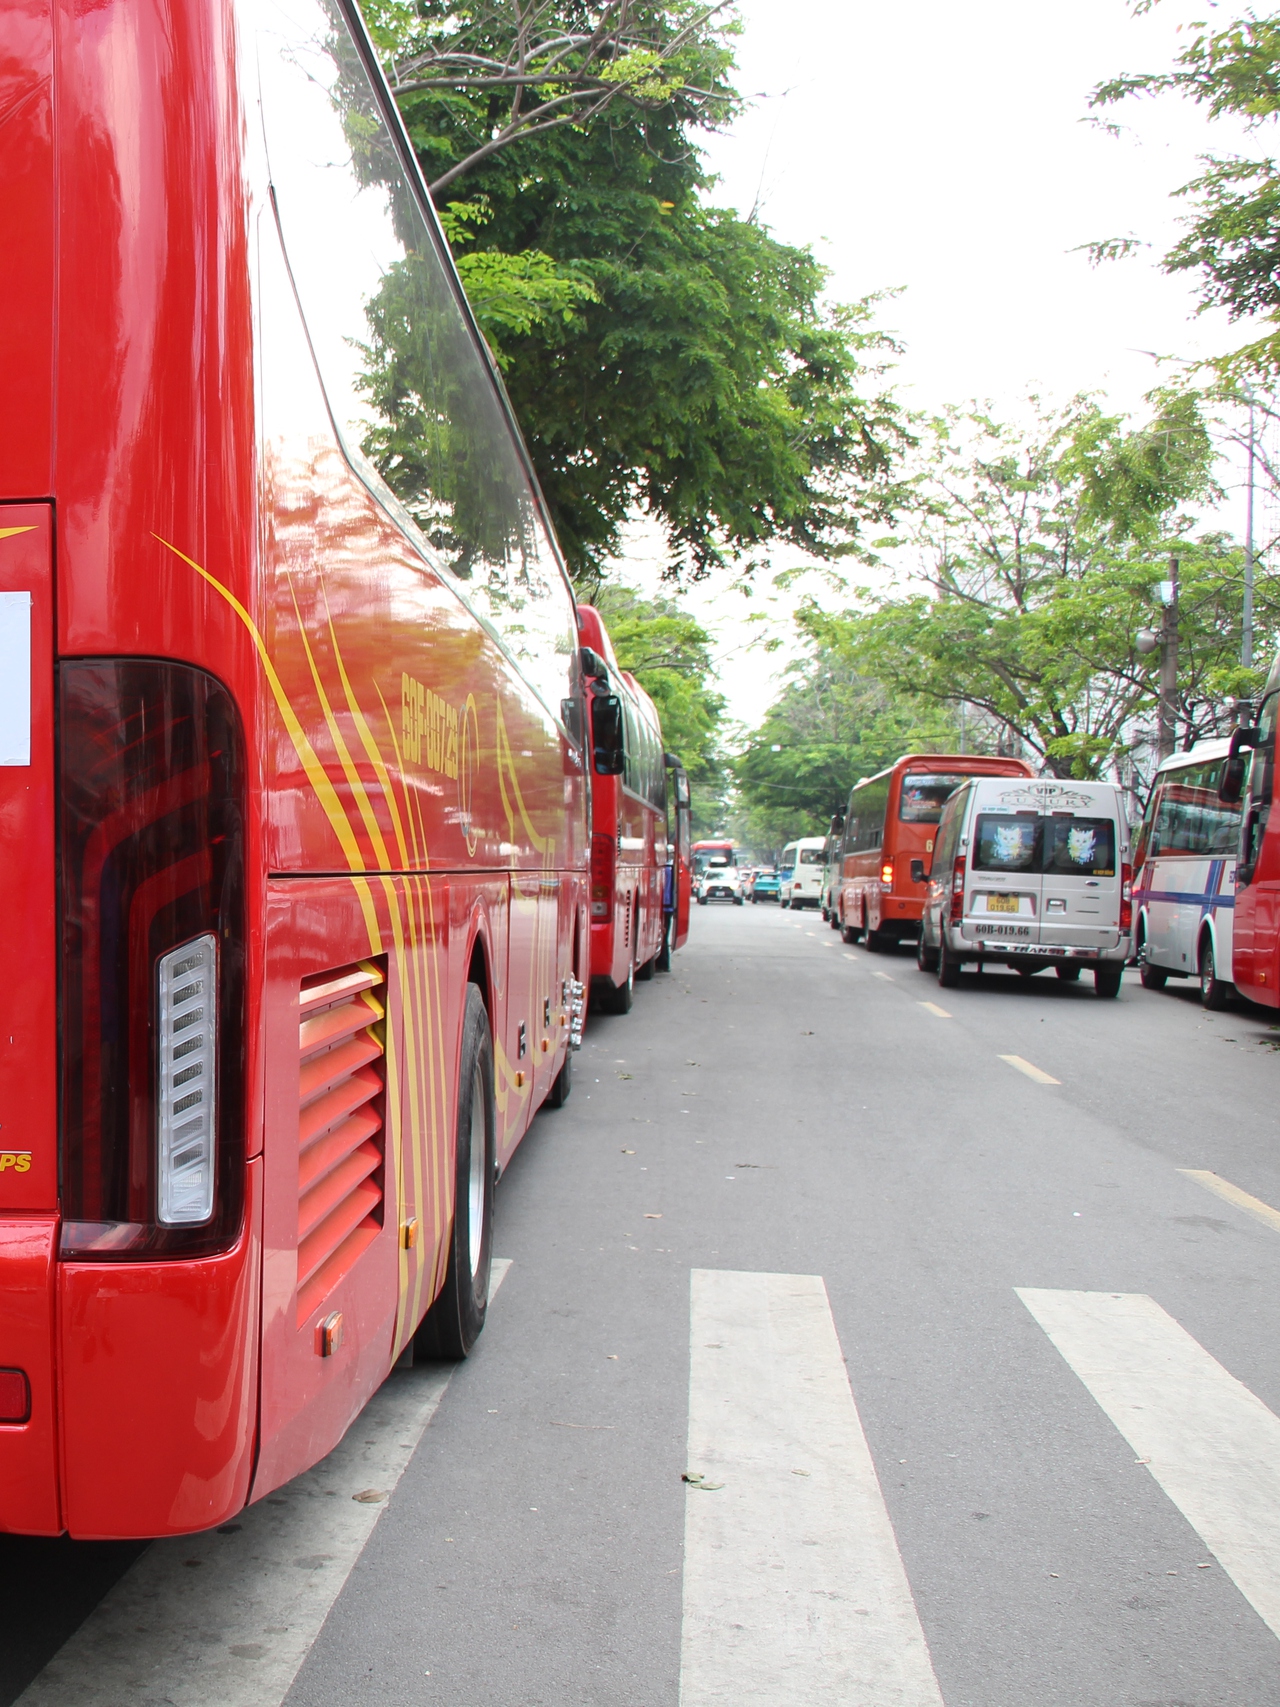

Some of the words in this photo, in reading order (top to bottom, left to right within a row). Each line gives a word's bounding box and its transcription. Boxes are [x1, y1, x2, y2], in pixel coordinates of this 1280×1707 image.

[1036, 787, 1057, 795] VIP
[1001, 796, 1091, 807] LUXURY
[975, 924, 1030, 936] 60B-019.66
